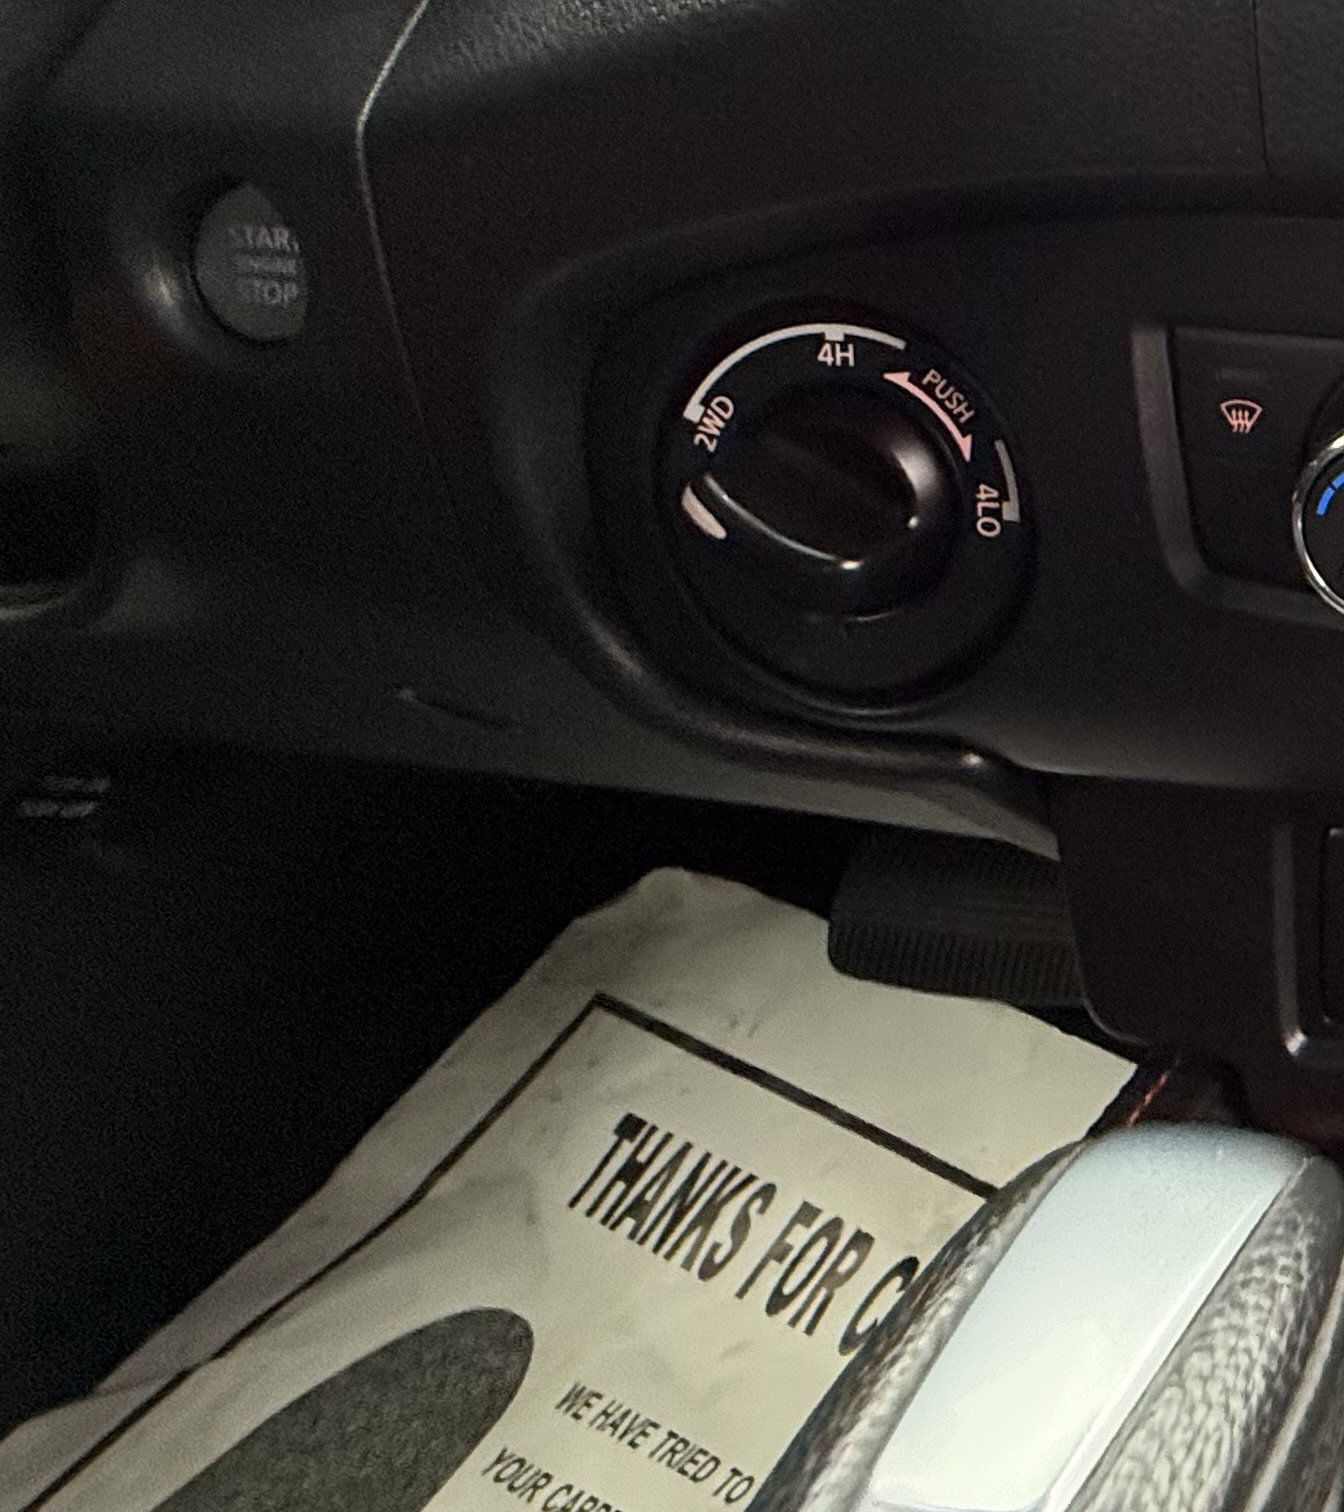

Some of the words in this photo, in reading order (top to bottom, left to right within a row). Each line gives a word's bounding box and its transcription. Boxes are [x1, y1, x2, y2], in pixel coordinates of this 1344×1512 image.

[816, 342, 856, 368] 4H
[693, 394, 735, 454] 2WD
[921, 367, 976, 425] PUSH
[975, 482, 1002, 538] 4LO
[566, 1111, 778, 1283] THANKS
[735, 1199, 876, 1337] FOR
[837, 1255, 920, 1357] C
[554, 1381, 604, 1422] WE
[588, 1398, 662, 1451] HAVE
[647, 1429, 723, 1485] TRIED
[711, 1466, 757, 1506] TO
[480, 1446, 555, 1505] YOUR
